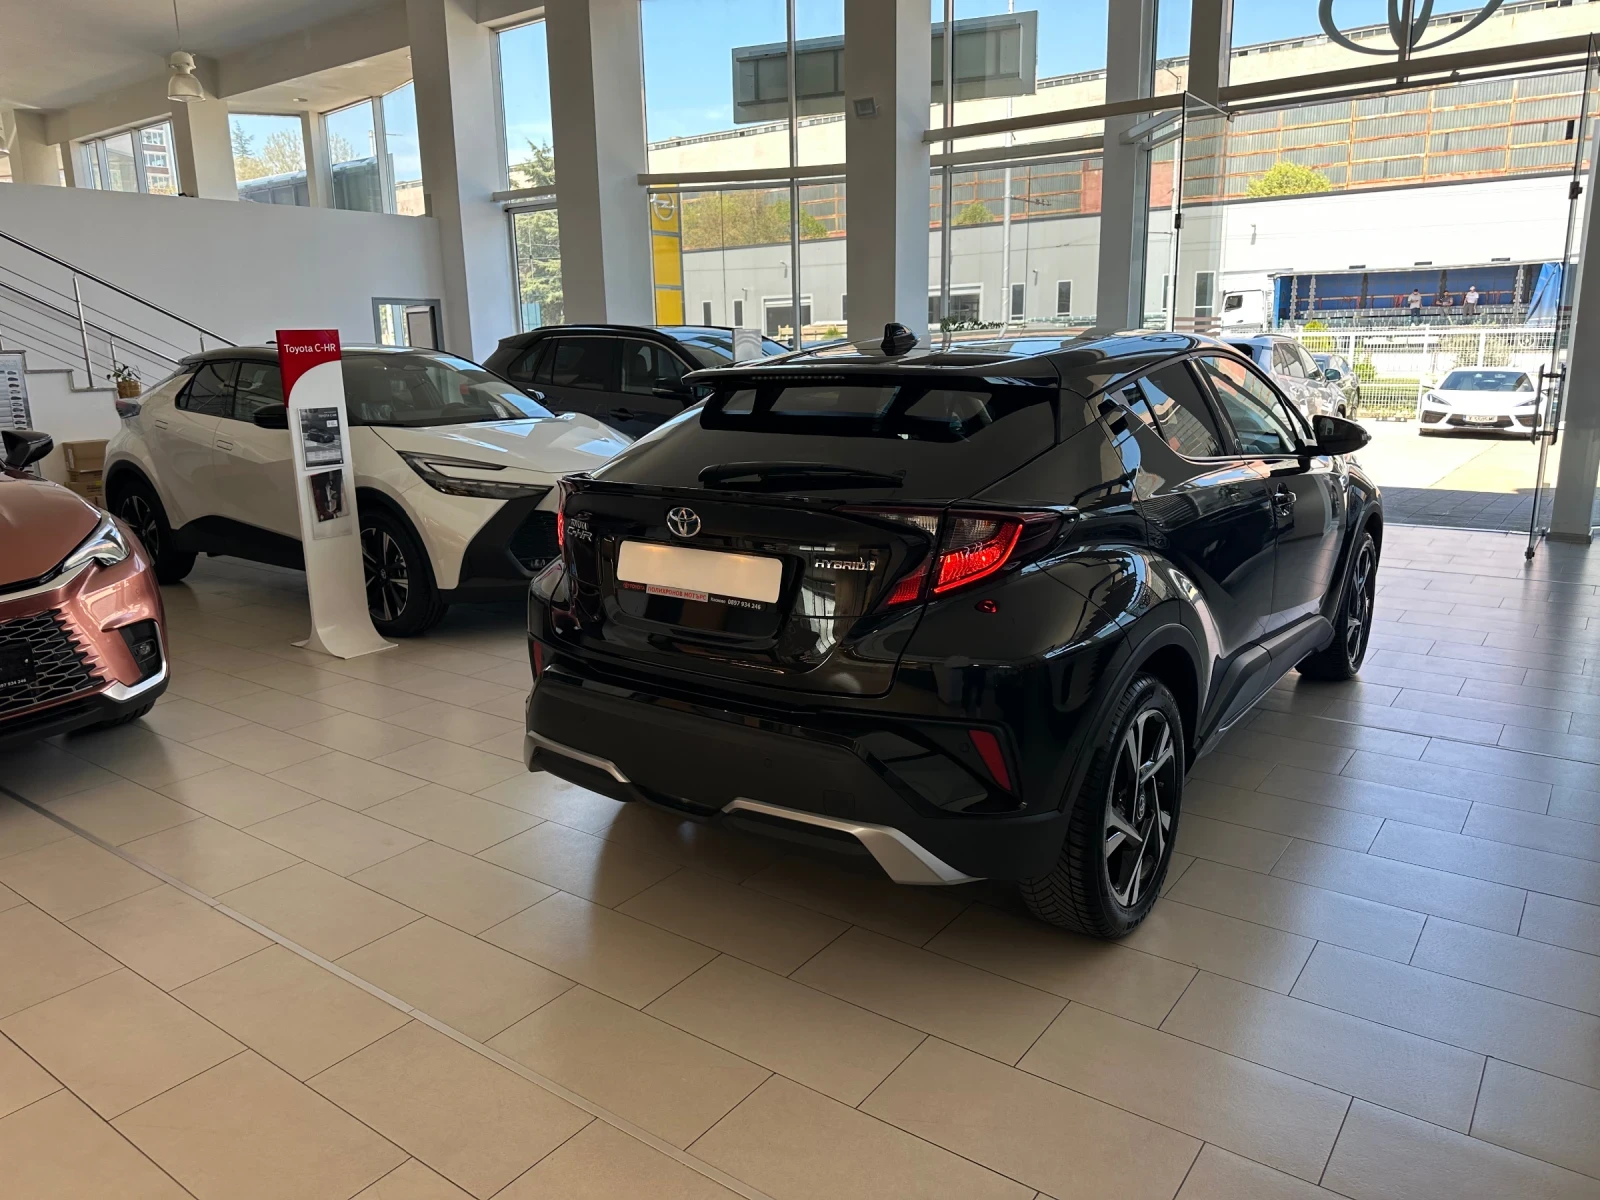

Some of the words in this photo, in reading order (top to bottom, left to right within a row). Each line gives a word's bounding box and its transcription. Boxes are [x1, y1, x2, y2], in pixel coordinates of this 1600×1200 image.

[284, 344, 313, 354] Toyota
[314, 343, 336, 352] C-HR
[567, 526, 592, 542] C-HR
[815, 559, 866, 571] HYBRID
[648, 586, 683, 597] ПОЛИХРОНОВ
[684, 591, 707, 601] МОТЪРС
